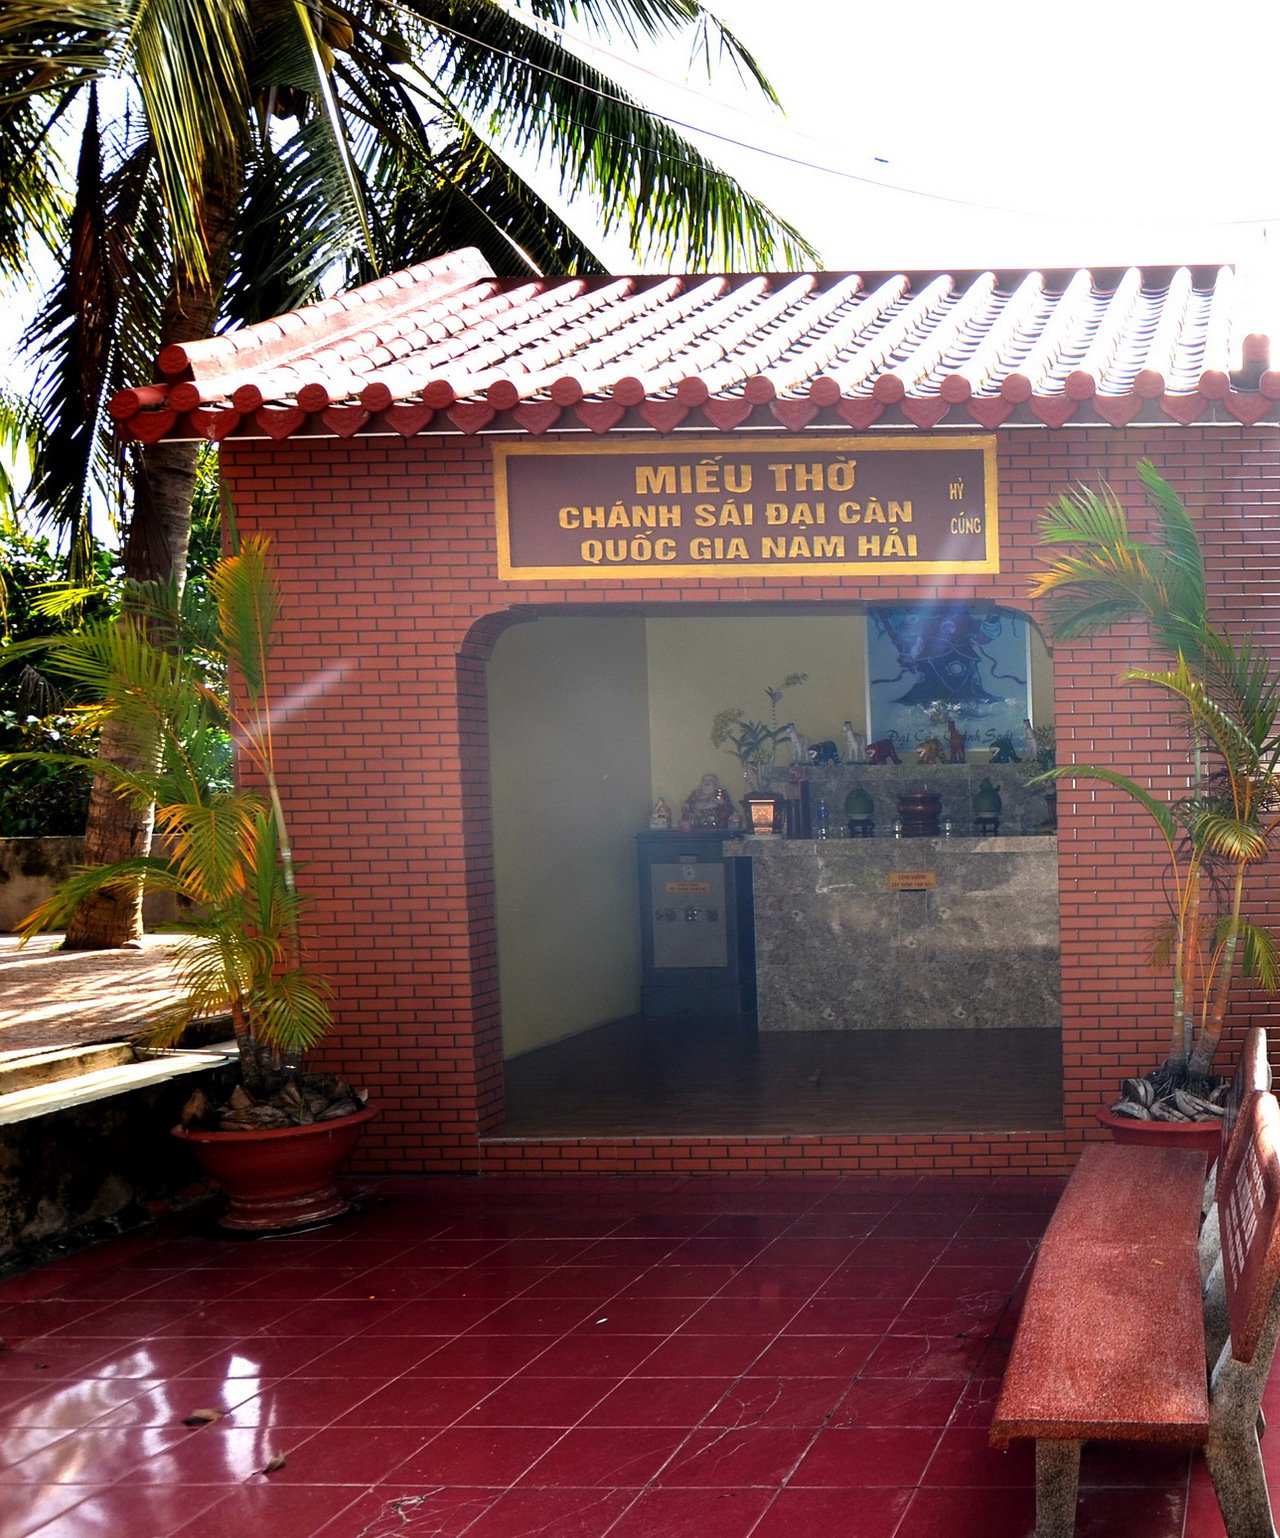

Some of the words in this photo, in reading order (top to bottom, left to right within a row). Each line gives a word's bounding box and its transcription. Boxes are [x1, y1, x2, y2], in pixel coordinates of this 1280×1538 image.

[635, 455, 752, 495] MIẾU
[768, 455, 857, 492] THỜ
[558, 500, 682, 529] CHÁNH
[694, 498, 753, 527] SÁI
[764, 502, 826, 530] ĐẠI
[838, 496, 912, 524] CÀN
[950, 512, 982, 535] CÚNG
[580, 530, 677, 564] QUỐC
[689, 537, 750, 560] GIA
[762, 535, 845, 559] NAM
[858, 526, 918, 557] HẢI
